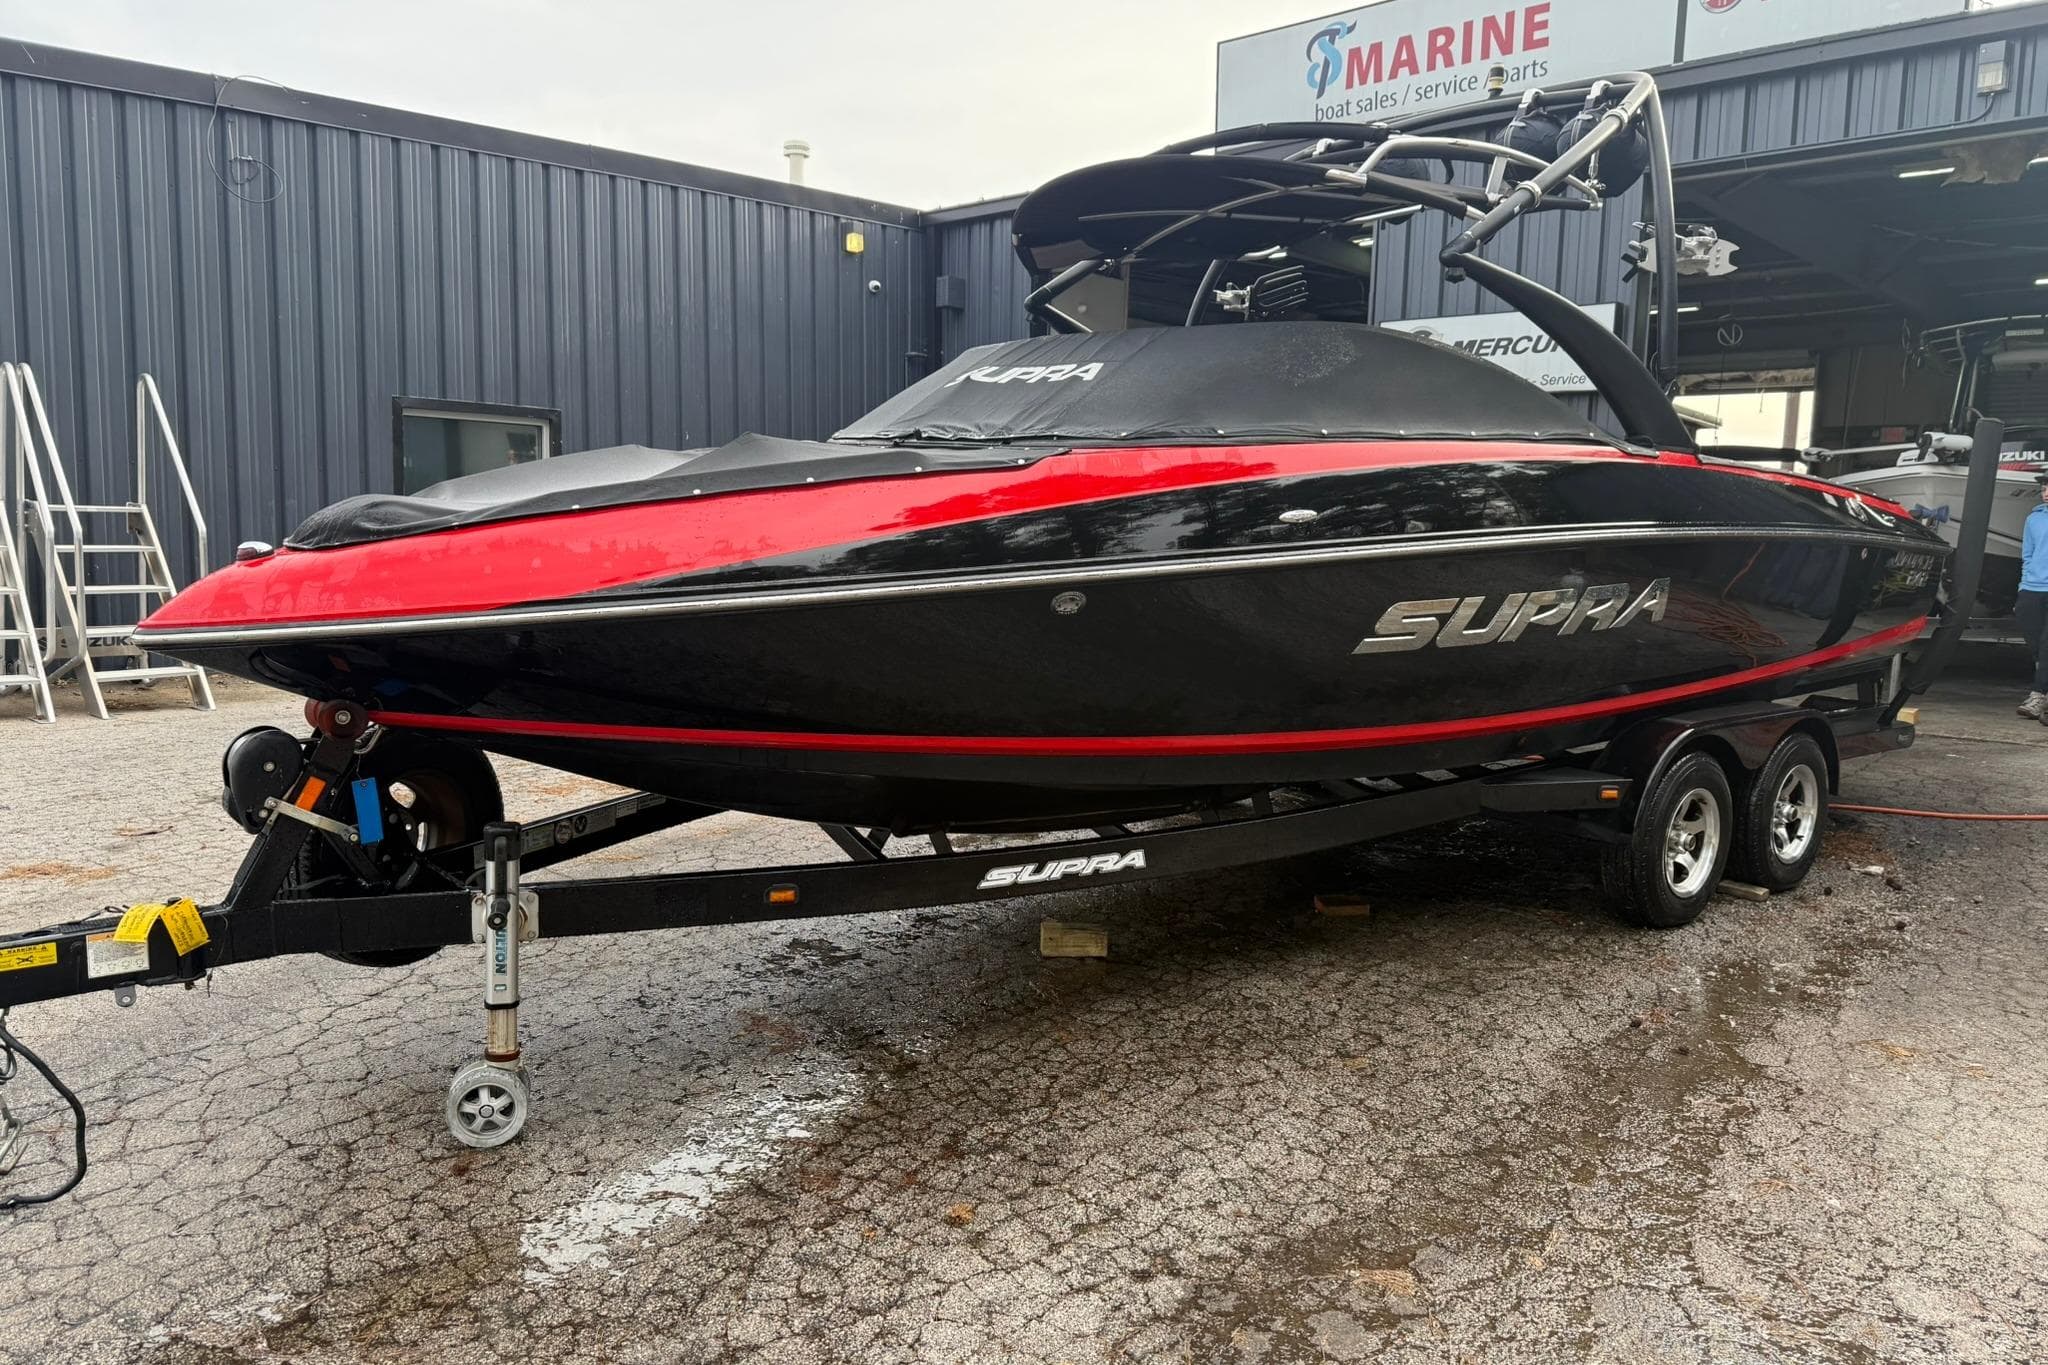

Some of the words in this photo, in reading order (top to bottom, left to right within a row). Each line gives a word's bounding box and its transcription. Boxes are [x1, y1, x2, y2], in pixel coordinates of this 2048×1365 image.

[1344, 2, 1551, 90] MARINE
[1315, 99, 1352, 122] boat
[1356, 90, 1397, 114] sales
[1415, 74, 1478, 102] service
[1540, 373, 1587, 386] Service
[1351, 577, 1671, 655] SUPRA
[976, 849, 1146, 890] SUPRA
[495, 927, 506, 975] ULTON
